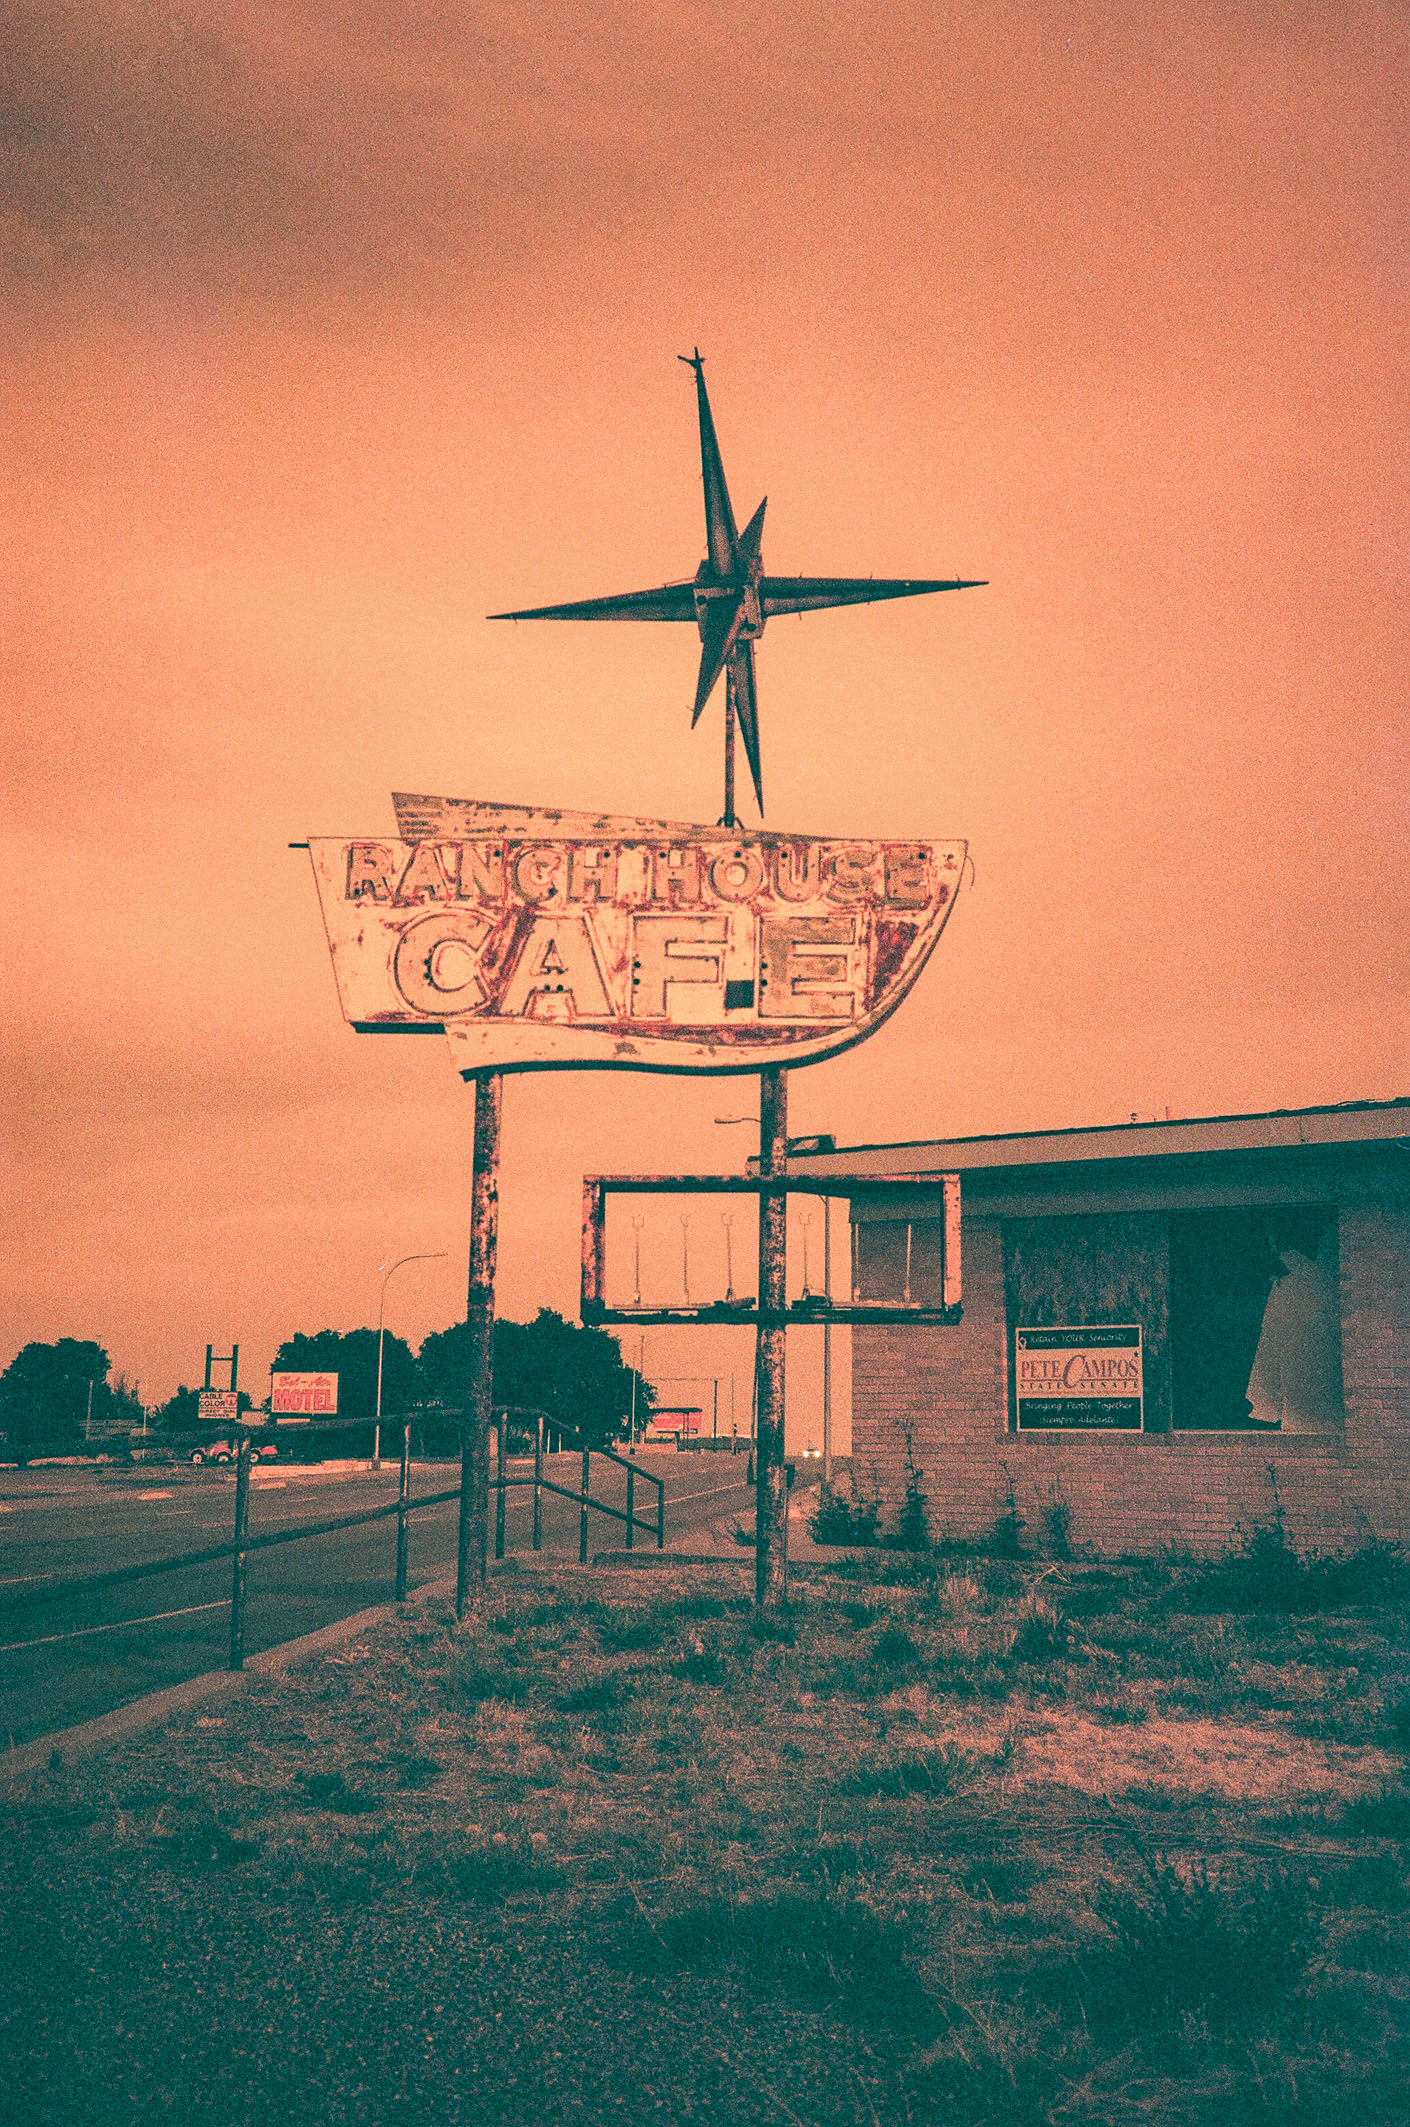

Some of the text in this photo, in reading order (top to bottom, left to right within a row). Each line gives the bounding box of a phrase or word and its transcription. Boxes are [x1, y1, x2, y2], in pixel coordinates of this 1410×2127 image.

[344, 842, 933, 905] RANCH HOUSE
[392, 906, 863, 1019] CAFE
[1062, 1333, 1085, 1343] YOUR
[1020, 1354, 1139, 1388] PETE CAMPOS
[1020, 1381, 1139, 1389] STATE SENATE
[274, 1388, 335, 1411] MOTEL
[1025, 1401, 1133, 1412] Bringing People Together
